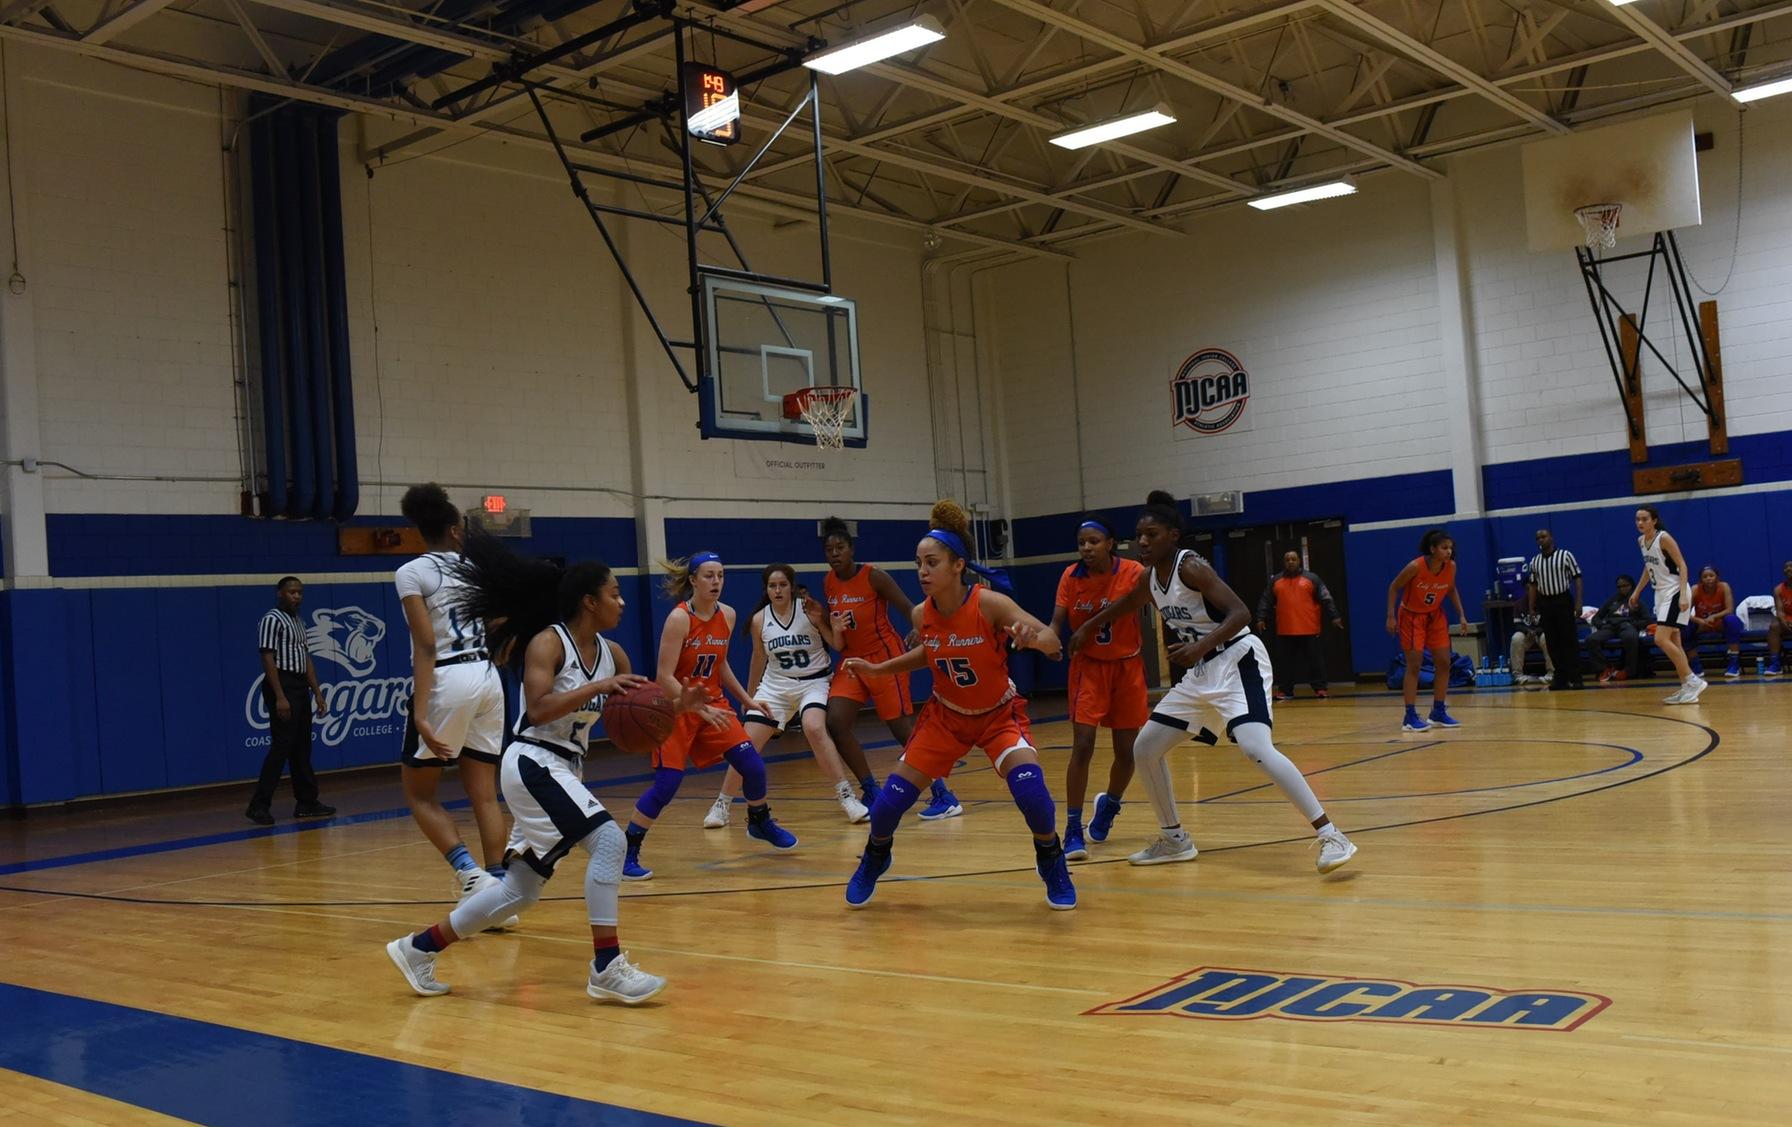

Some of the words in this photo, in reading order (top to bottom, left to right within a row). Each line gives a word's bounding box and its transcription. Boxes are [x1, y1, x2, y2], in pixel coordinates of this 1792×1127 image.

[1173, 371, 1248, 422] NJCAA
[766, 459, 793, 469] OFFICIAL
[795, 461, 825, 470] OUTFITTER
[1073, 599, 1093, 611] Lady
[1424, 592, 1437, 607] 5
[946, 633, 984, 648] Runners
[1095, 620, 1113, 646] 3
[767, 634, 812, 652] COUGARS
[690, 653, 718, 679] 11
[774, 649, 811, 670] 50
[934, 657, 979, 689] 15
[353, 724, 392, 737] COLLEGE
[1117, 971, 1589, 1026] NJCAA
